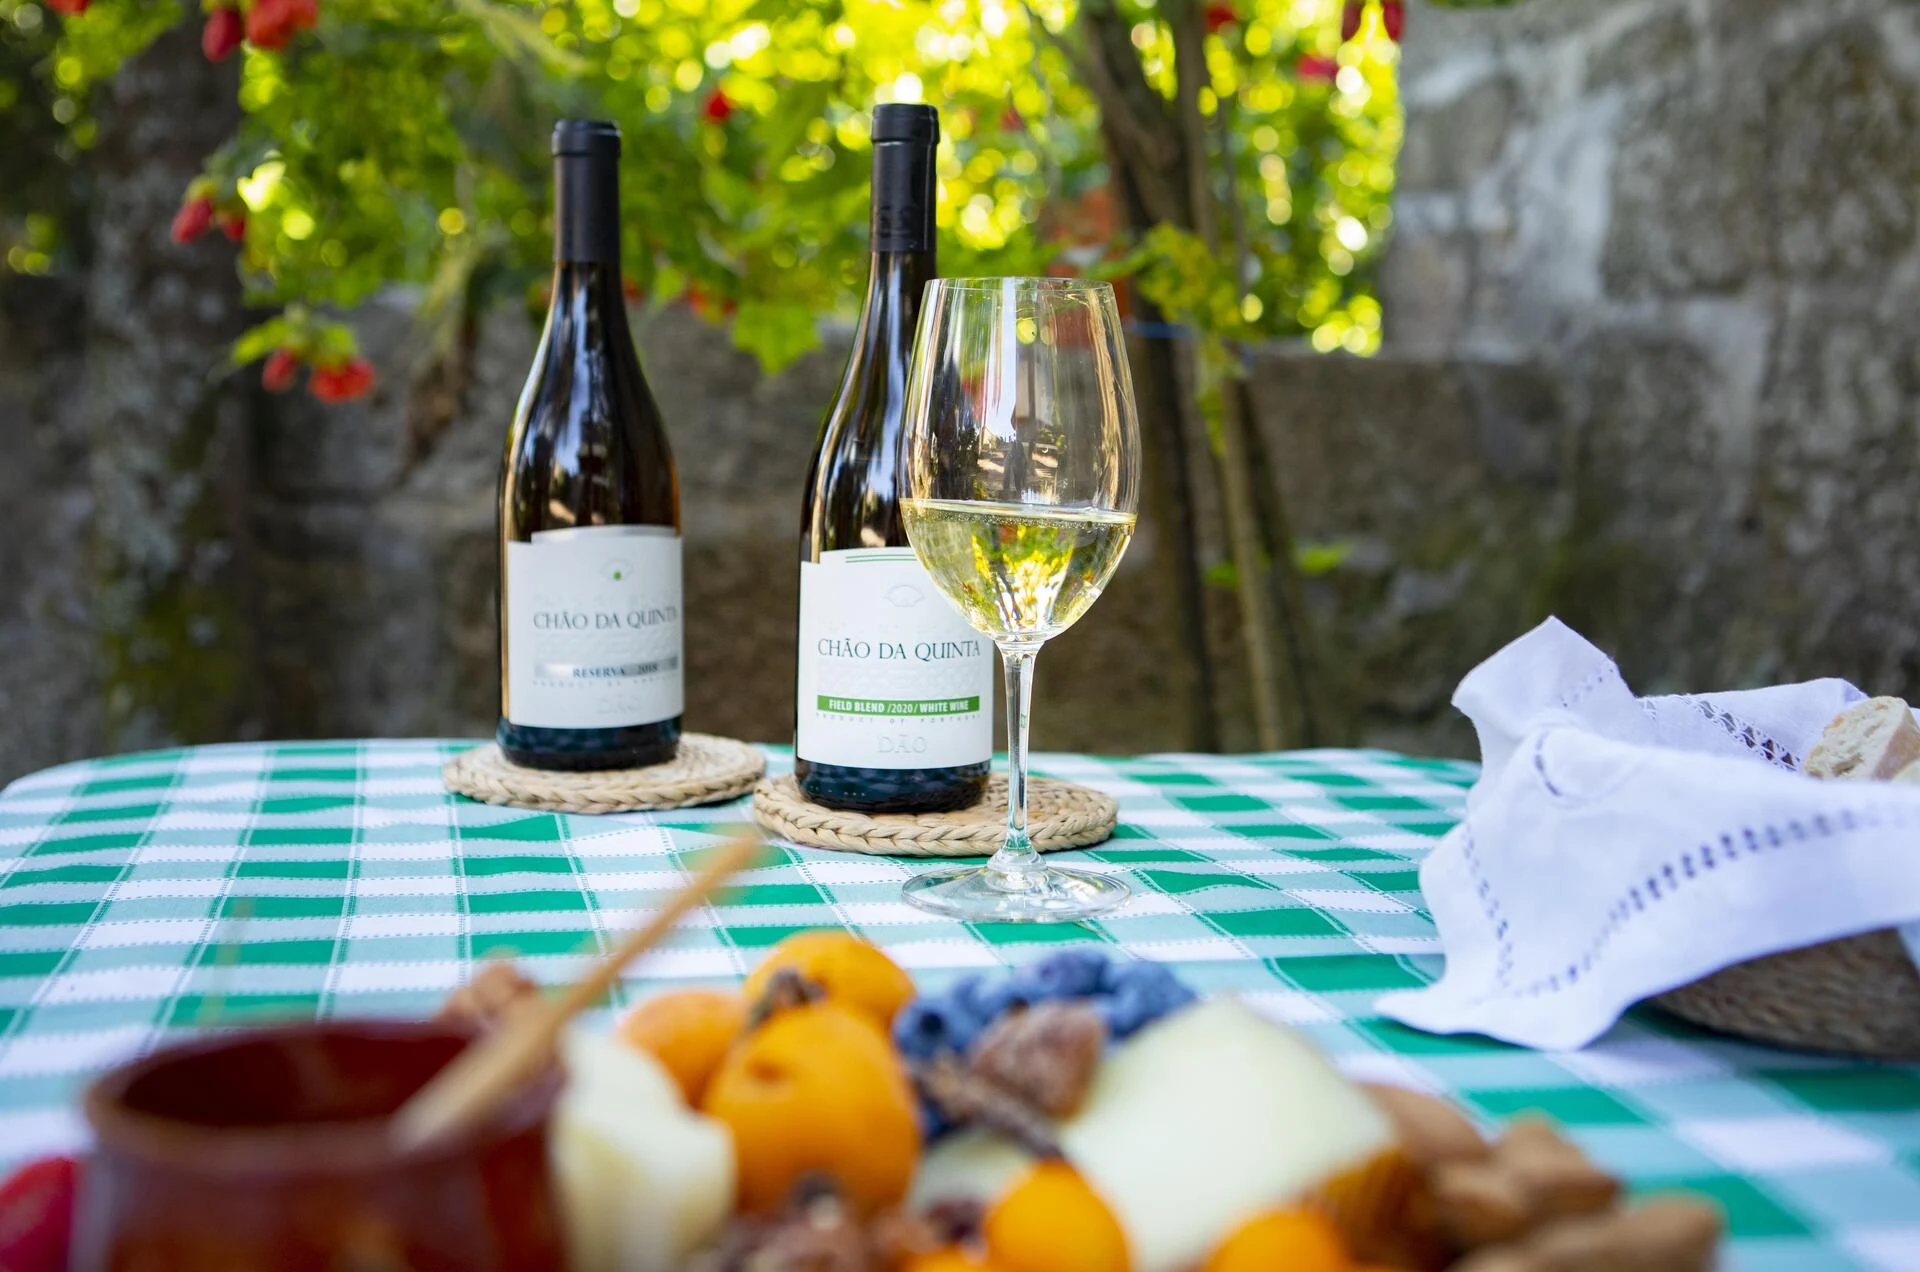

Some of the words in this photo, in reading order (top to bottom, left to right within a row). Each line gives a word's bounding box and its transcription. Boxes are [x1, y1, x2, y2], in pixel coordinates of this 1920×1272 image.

[533, 611, 588, 629] CHÃO
[595, 613, 621, 629] DA
[818, 638, 871, 658] CHÃO
[879, 642, 907, 660] DA
[915, 639, 981, 662] QUINTA
[573, 666, 625, 678] RESERVA
[829, 699, 852, 711] FIELD
[855, 701, 884, 712] BLEND
[920, 702, 947, 713] WHITE
[949, 701, 968, 711] WINE
[877, 733, 928, 754] DÃO
